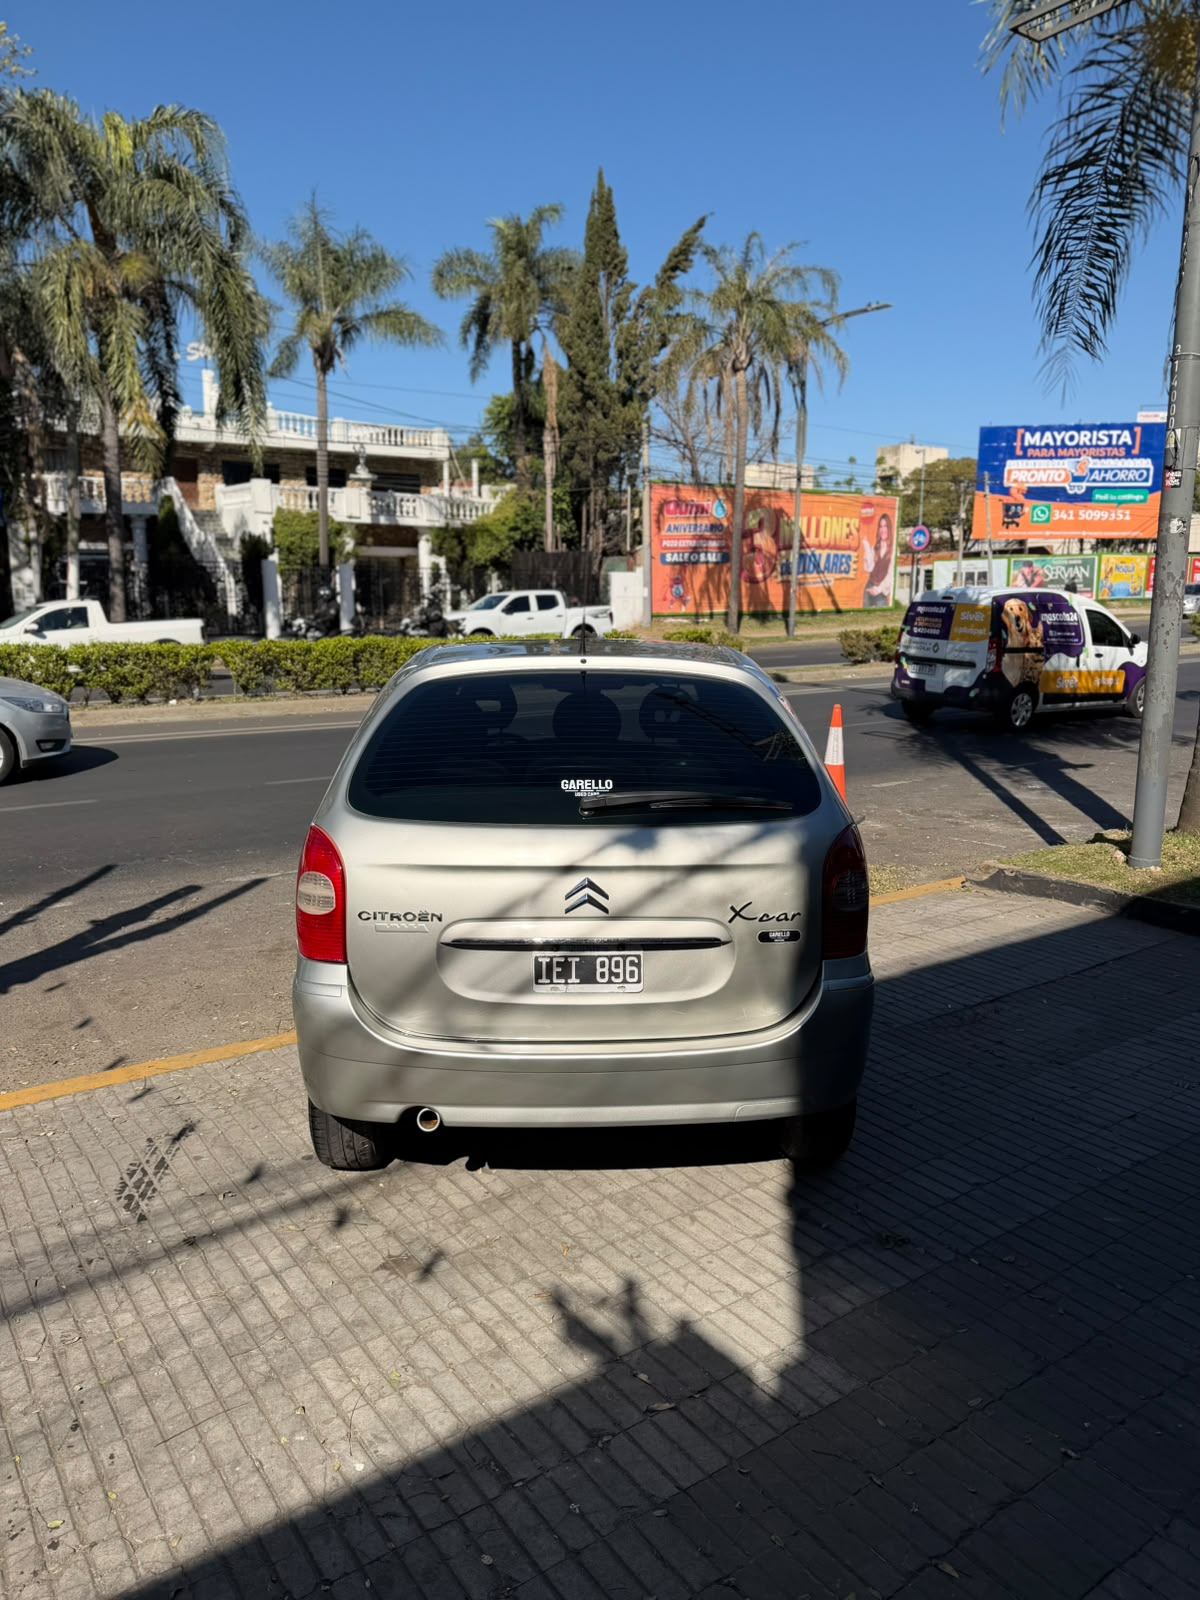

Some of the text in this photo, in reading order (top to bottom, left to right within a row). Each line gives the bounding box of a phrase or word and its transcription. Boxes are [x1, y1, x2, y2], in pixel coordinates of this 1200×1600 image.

[1023, 429, 1132, 447] MAYORISTA
[1027, 447, 1126, 458] PARA MAYORISTAS
[1011, 469, 1148, 482] PRONTO AHORRO
[1053, 510, 1074, 521] 341
[666, 523, 724, 534] ANIVERSARIO
[779, 515, 859, 546] MLLONES
[665, 553, 690, 563] SALE
[561, 779, 613, 790] GARELLO
[357, 910, 443, 922] CITROËN
[538, 957, 639, 983] IEI 896
